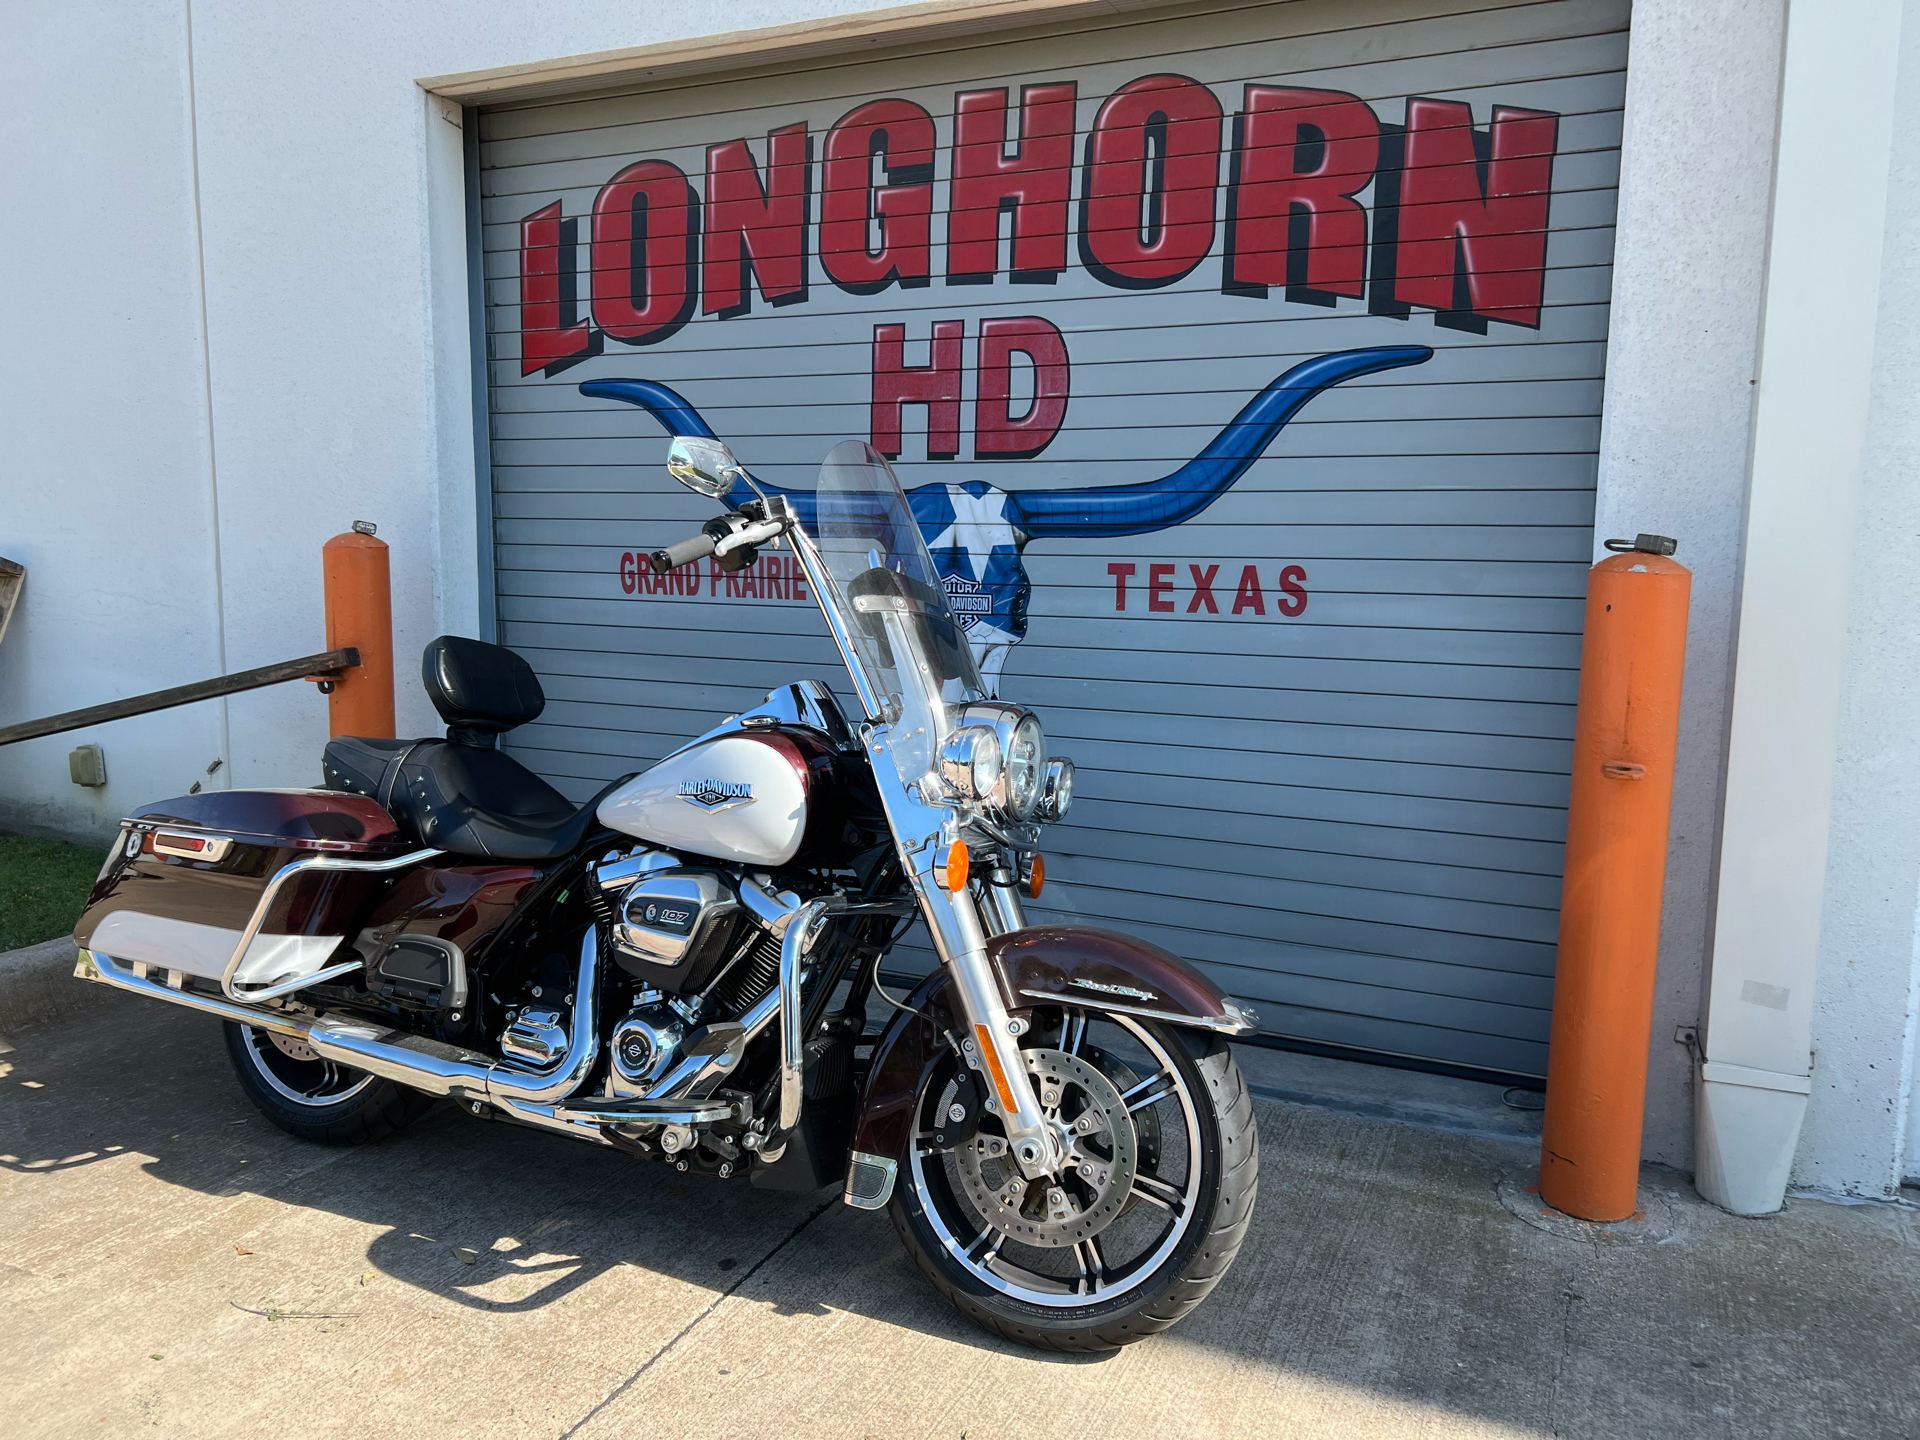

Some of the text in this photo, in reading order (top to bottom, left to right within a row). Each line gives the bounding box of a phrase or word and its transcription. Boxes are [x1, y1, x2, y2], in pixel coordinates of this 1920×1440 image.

[520, 72, 1561, 378] LONGHORN
[871, 315, 1070, 460] HD
[620, 551, 807, 601] GRAND PRAIRIE
[1107, 562, 1308, 617] TEXAS
[952, 598, 988, 611] DAVIDSON
[679, 778, 752, 797] HARLEY-DAVIDSON
[660, 909, 690, 921] 107
